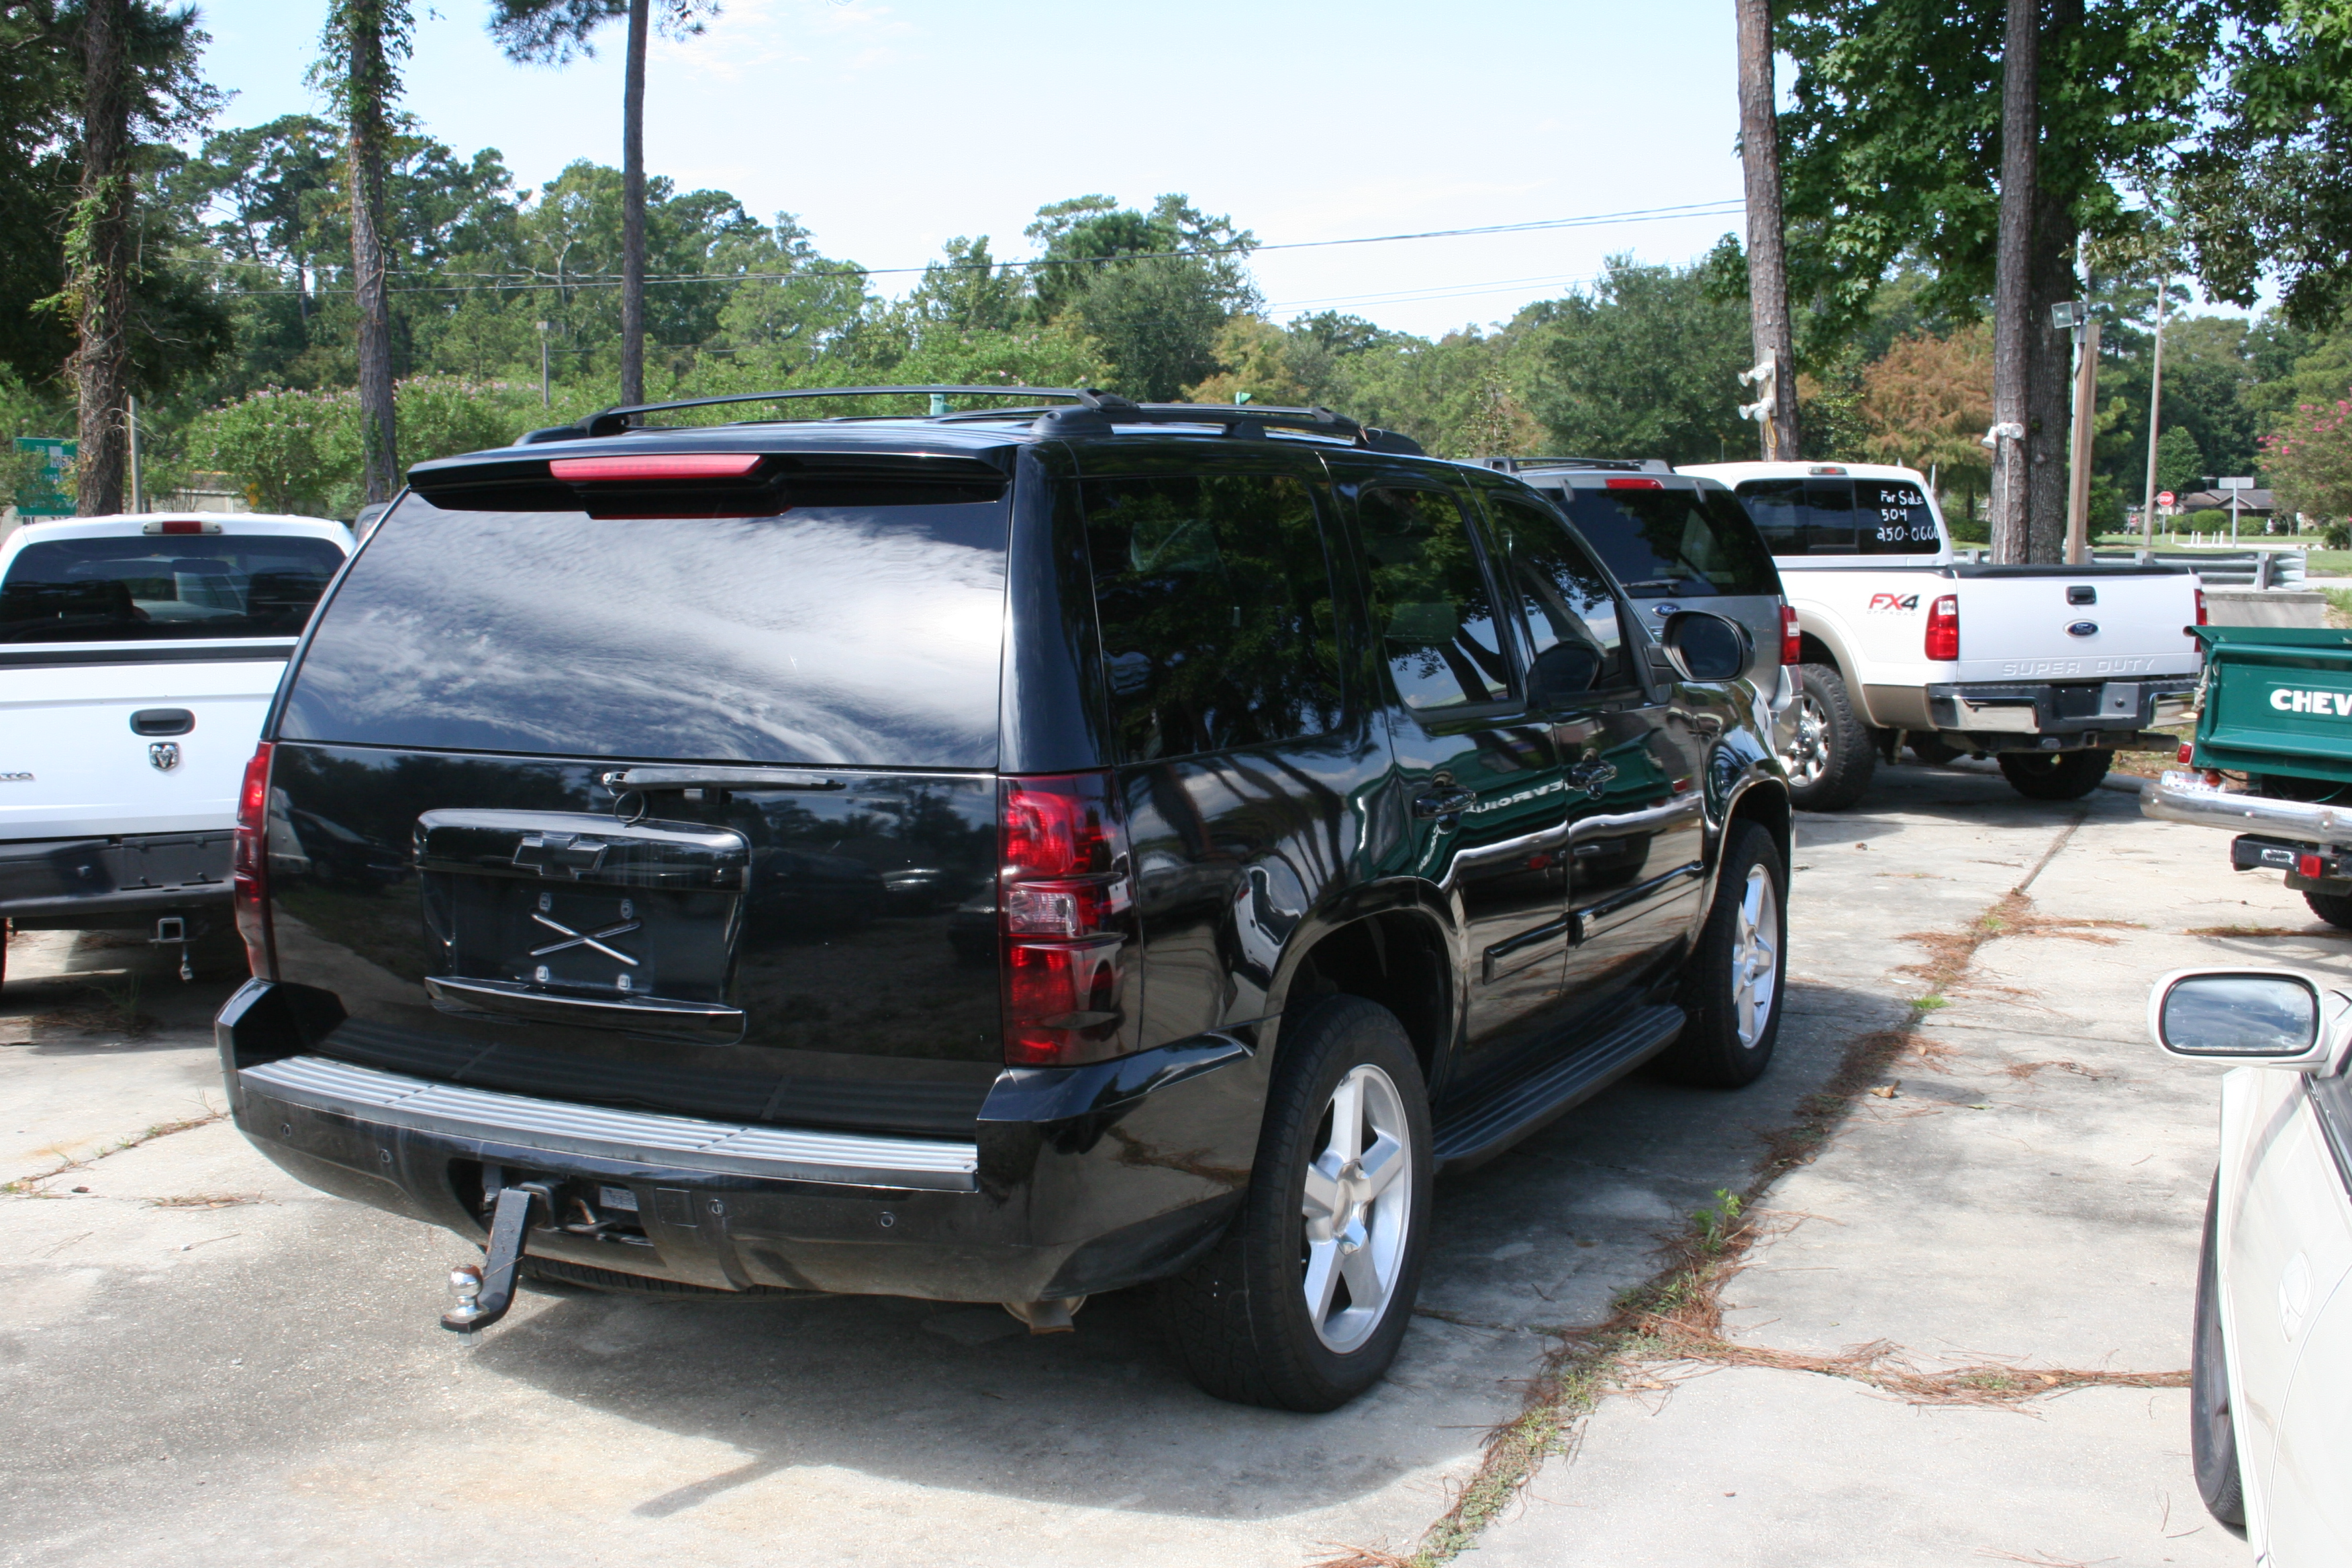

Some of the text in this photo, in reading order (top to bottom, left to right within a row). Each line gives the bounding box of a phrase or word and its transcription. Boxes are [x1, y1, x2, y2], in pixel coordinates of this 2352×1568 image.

[1881, 490, 1924, 505] For Sale
[1881, 508, 1907, 522] 504
[1869, 593, 1920, 610] FX4
[2074, 623, 2093, 634] Ford
[2003, 658, 2155, 677] SUPER DUTY
[2269, 688, 2352, 716] CHEV
